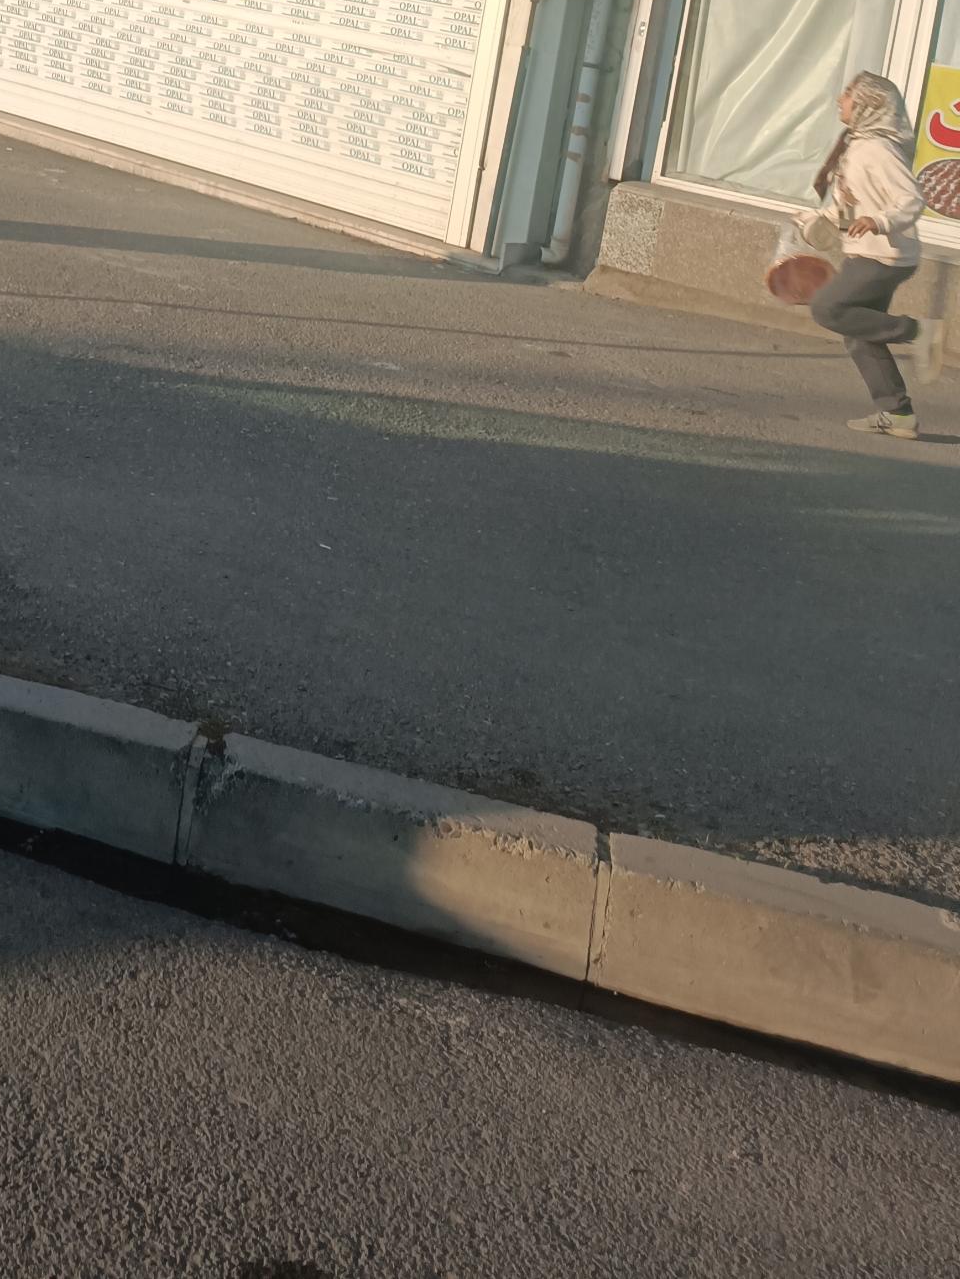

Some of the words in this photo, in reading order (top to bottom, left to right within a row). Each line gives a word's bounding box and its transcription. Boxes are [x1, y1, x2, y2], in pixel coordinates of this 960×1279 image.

[244, 0, 264, 10] OPAL
[290, 7, 311, 19] OPAL
[338, 17, 360, 28] OPAL
[390, 27, 413, 39] OPAL
[344, 4, 366, 16] OPAL
[395, 14, 419, 26] OPAL
[398, 2, 422, 13] OPAL
[90, 15, 107, 25] OPAL
[213, 41, 232, 53] OPAL
[258, 51, 278, 63] OPAL
[306, 61, 327, 73] OPAL
[356, 72, 378, 85] OPAL
[409, 84, 432, 97] OPAL
[143, 15, 161, 25] OPAL
[229, 33, 248, 44] OPAL
[275, 42, 296, 54] OPAL
[323, 52, 345, 64] OPAL
[374, 63, 397, 75] OPAL
[428, 75, 453, 87] OPAL
[291, 32, 312, 44] OPAL
[199, 51, 218, 62] OPAL
[290, 71, 311, 83] OPAL
[340, 82, 362, 95] OPAL
[392, 94, 415, 107] OPAL
[51, 72, 67, 82] OPAL
[126, 91, 144, 102] OPAL
[401, 161, 425, 175] OPAL
[399, 148, 423, 162] OPAL
